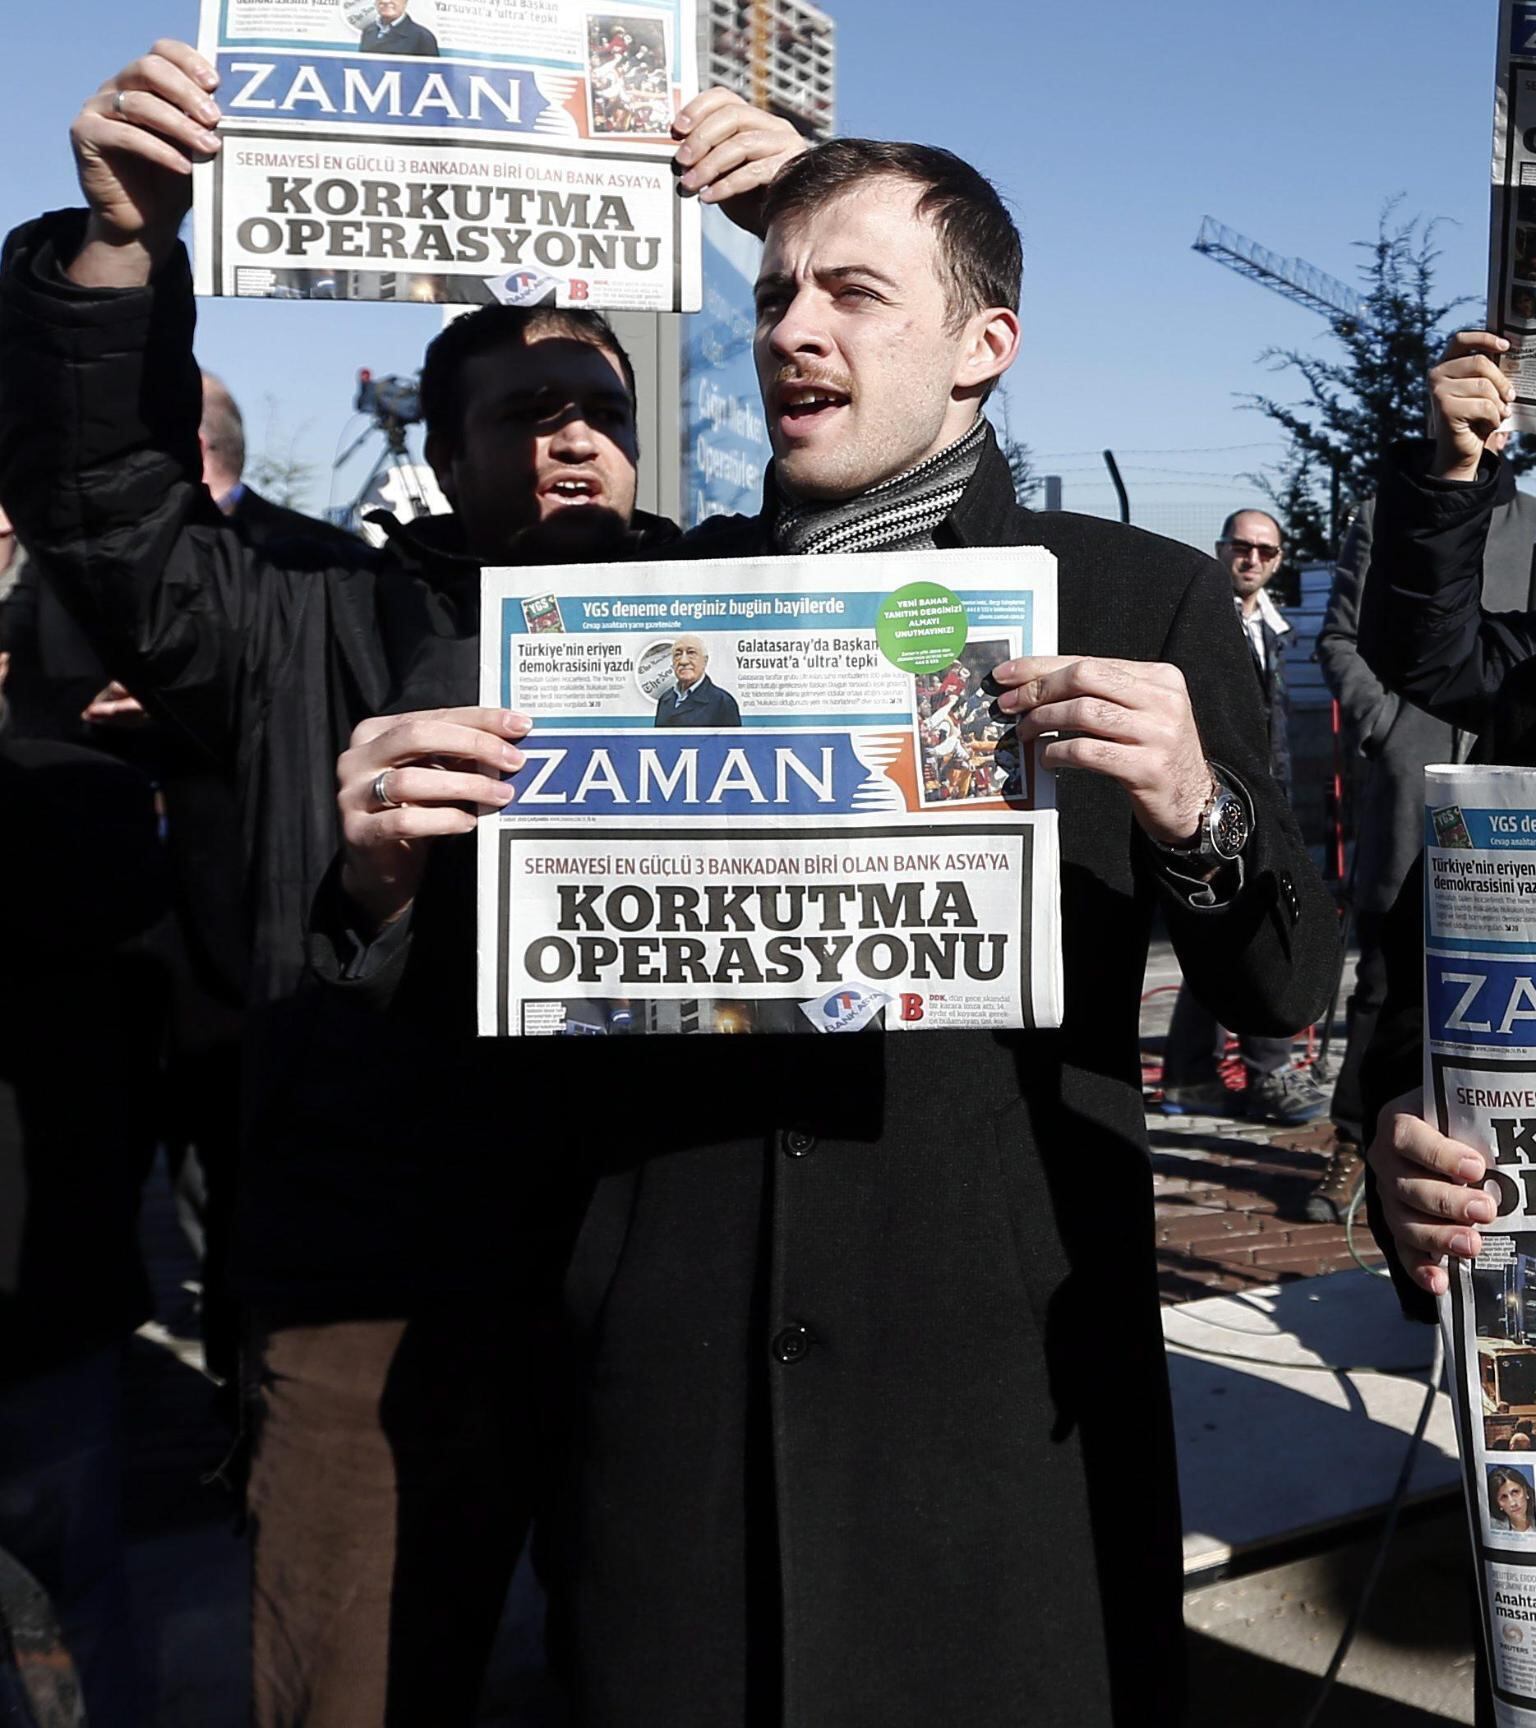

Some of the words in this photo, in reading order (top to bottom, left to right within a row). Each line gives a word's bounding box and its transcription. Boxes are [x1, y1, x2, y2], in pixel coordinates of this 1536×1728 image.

[230, 62, 522, 123] ZAMAN
[236, 152, 320, 169] SERMAYESİ
[323, 156, 342, 170] EN
[398, 159, 406, 172] 3
[410, 160, 489, 178] BANKADAN
[494, 161, 522, 179] BİRİ
[525, 167, 562, 182] OLAN
[566, 169, 604, 186] BANK
[609, 172, 662, 190] ASYA'YA
[266, 175, 635, 231] KORKUTMA
[237, 216, 662, 271] OPERASYONU
[582, 602, 609, 618] YGS
[612, 600, 668, 617] deneme
[670, 598, 725, 620] derginiz
[729, 598, 772, 618] bugün
[775, 597, 845, 618] bayilerde
[908, 617, 940, 627] ALMAYI
[518, 643, 584, 659] Türkiye'nin
[586, 643, 622, 660] eriyen
[737, 639, 829, 655] Galatasaray'da
[833, 638, 879, 653] Başkan
[519, 658, 601, 673] demokrasisini
[604, 658, 633, 674] yazdı
[736, 655, 799, 670] Yarsuvat'a
[846, 654, 878, 670] tepki
[517, 747, 836, 804] ZAMAN
[1489, 816, 1517, 833] YGS
[524, 856, 611, 875] SERMAYESİ
[616, 858, 635, 875] EN
[640, 855, 691, 877] GÜÇLÜ
[696, 858, 704, 875] 3
[708, 857, 800, 875] BANKADAN
[804, 855, 837, 874] BİRİ
[843, 856, 888, 873] OLAN
[894, 854, 940, 872] BANK
[945, 853, 1009, 871] ASYA'YA
[1432, 857, 1495, 876] Türkiye'nin
[1497, 861, 1536, 878] eriyen
[1434, 876, 1514, 894] demokrasisini
[557, 881, 978, 931] KORKUTMA
[524, 933, 1008, 983] OPERASYONU
[900, 993, 923, 1021] B
